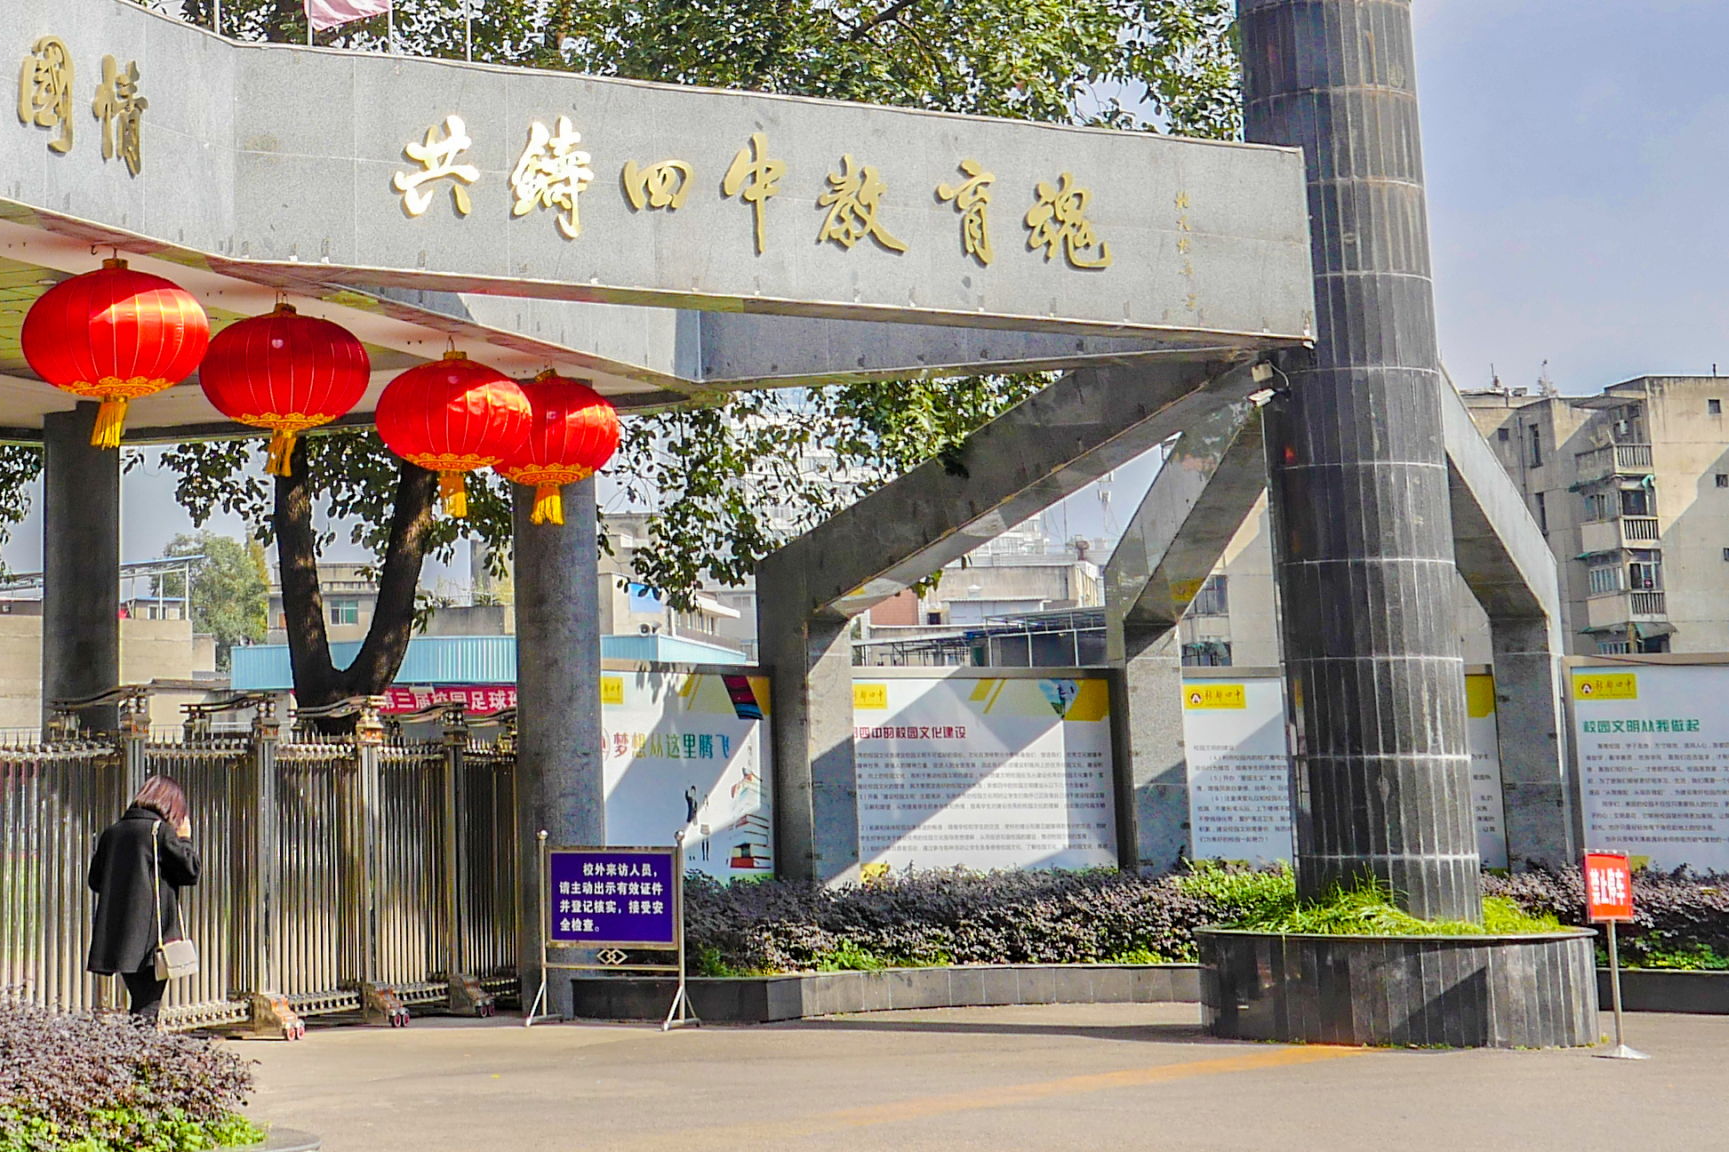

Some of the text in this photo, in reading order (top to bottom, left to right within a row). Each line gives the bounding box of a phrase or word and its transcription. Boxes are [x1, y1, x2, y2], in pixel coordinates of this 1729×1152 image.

[1583, 719, 1700, 733] 校园文明从我做起
[614, 732, 729, 759] 梦想从这里腾飞
[559, 881, 663, 896] 请主动出示有效证件
[1589, 868, 1626, 906] 禁止停车
